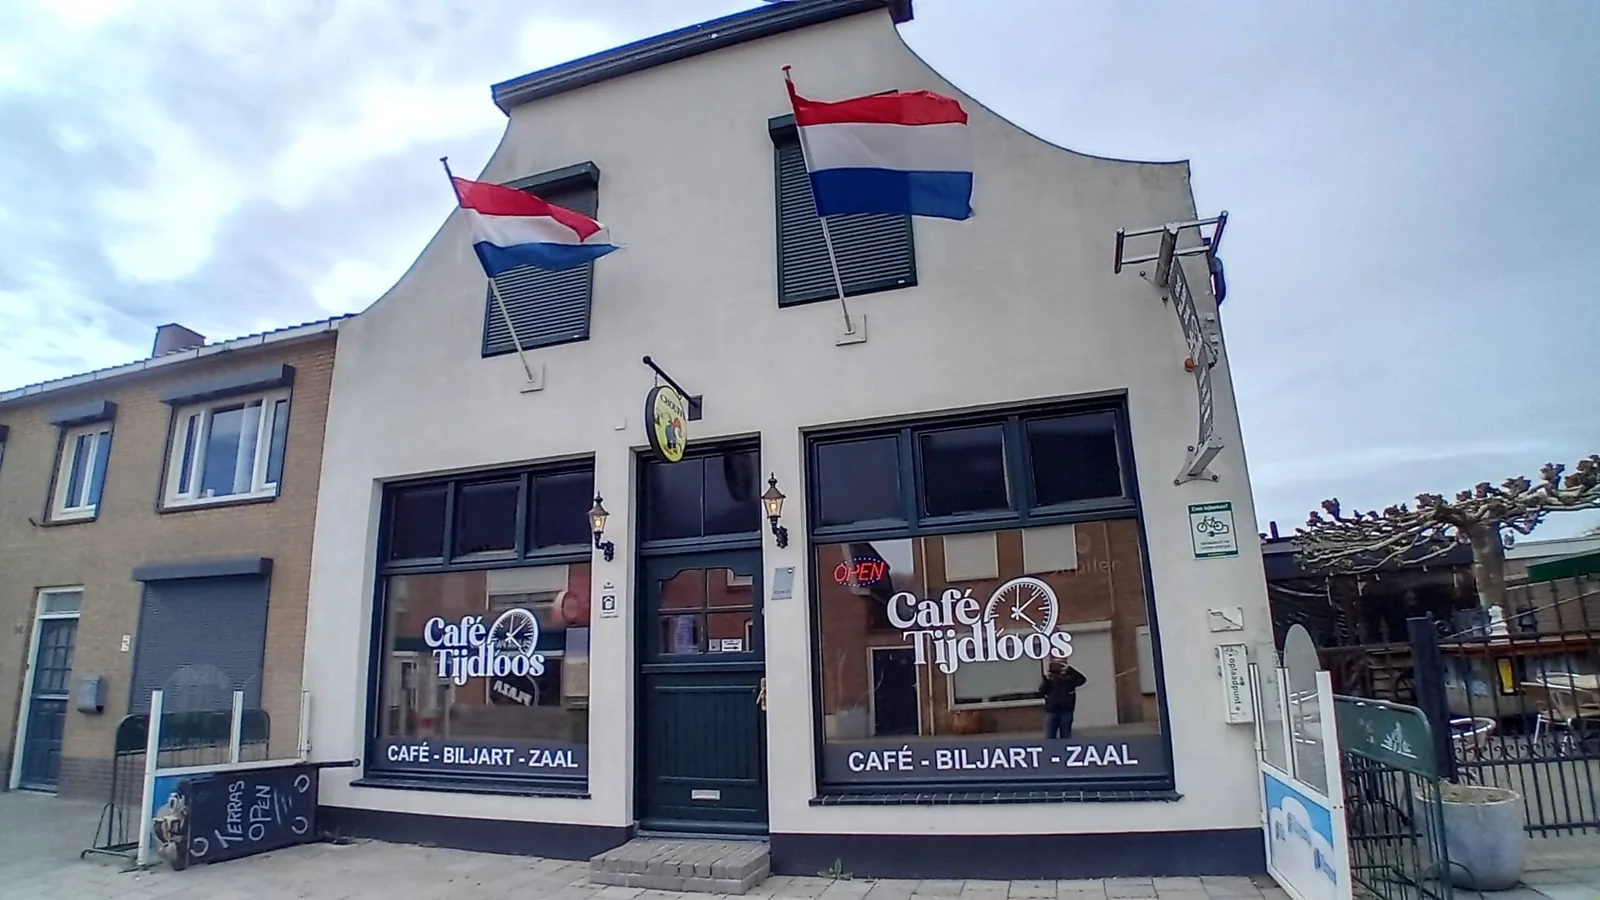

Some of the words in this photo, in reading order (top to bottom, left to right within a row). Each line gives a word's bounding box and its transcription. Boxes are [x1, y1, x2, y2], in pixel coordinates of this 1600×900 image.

[834, 562, 884, 582] OPEN
[887, 588, 981, 629] Café
[424, 616, 486, 648] Café
[903, 618, 1073, 674] Tijdloos
[433, 640, 545, 685] Tijdloos
[1228, 657, 1242, 704] oplaadpunt
[388, 741, 429, 763] CAFÉ
[443, 747, 514, 766] BILJART
[529, 750, 578, 768] ZAAL
[849, 745, 913, 772] CAFÉ
[936, 747, 1042, 770] BILJART
[1066, 745, 1138, 767] ZAAL
[214, 780, 245, 848] TERRAS
[249, 785, 272, 841] OPEN
